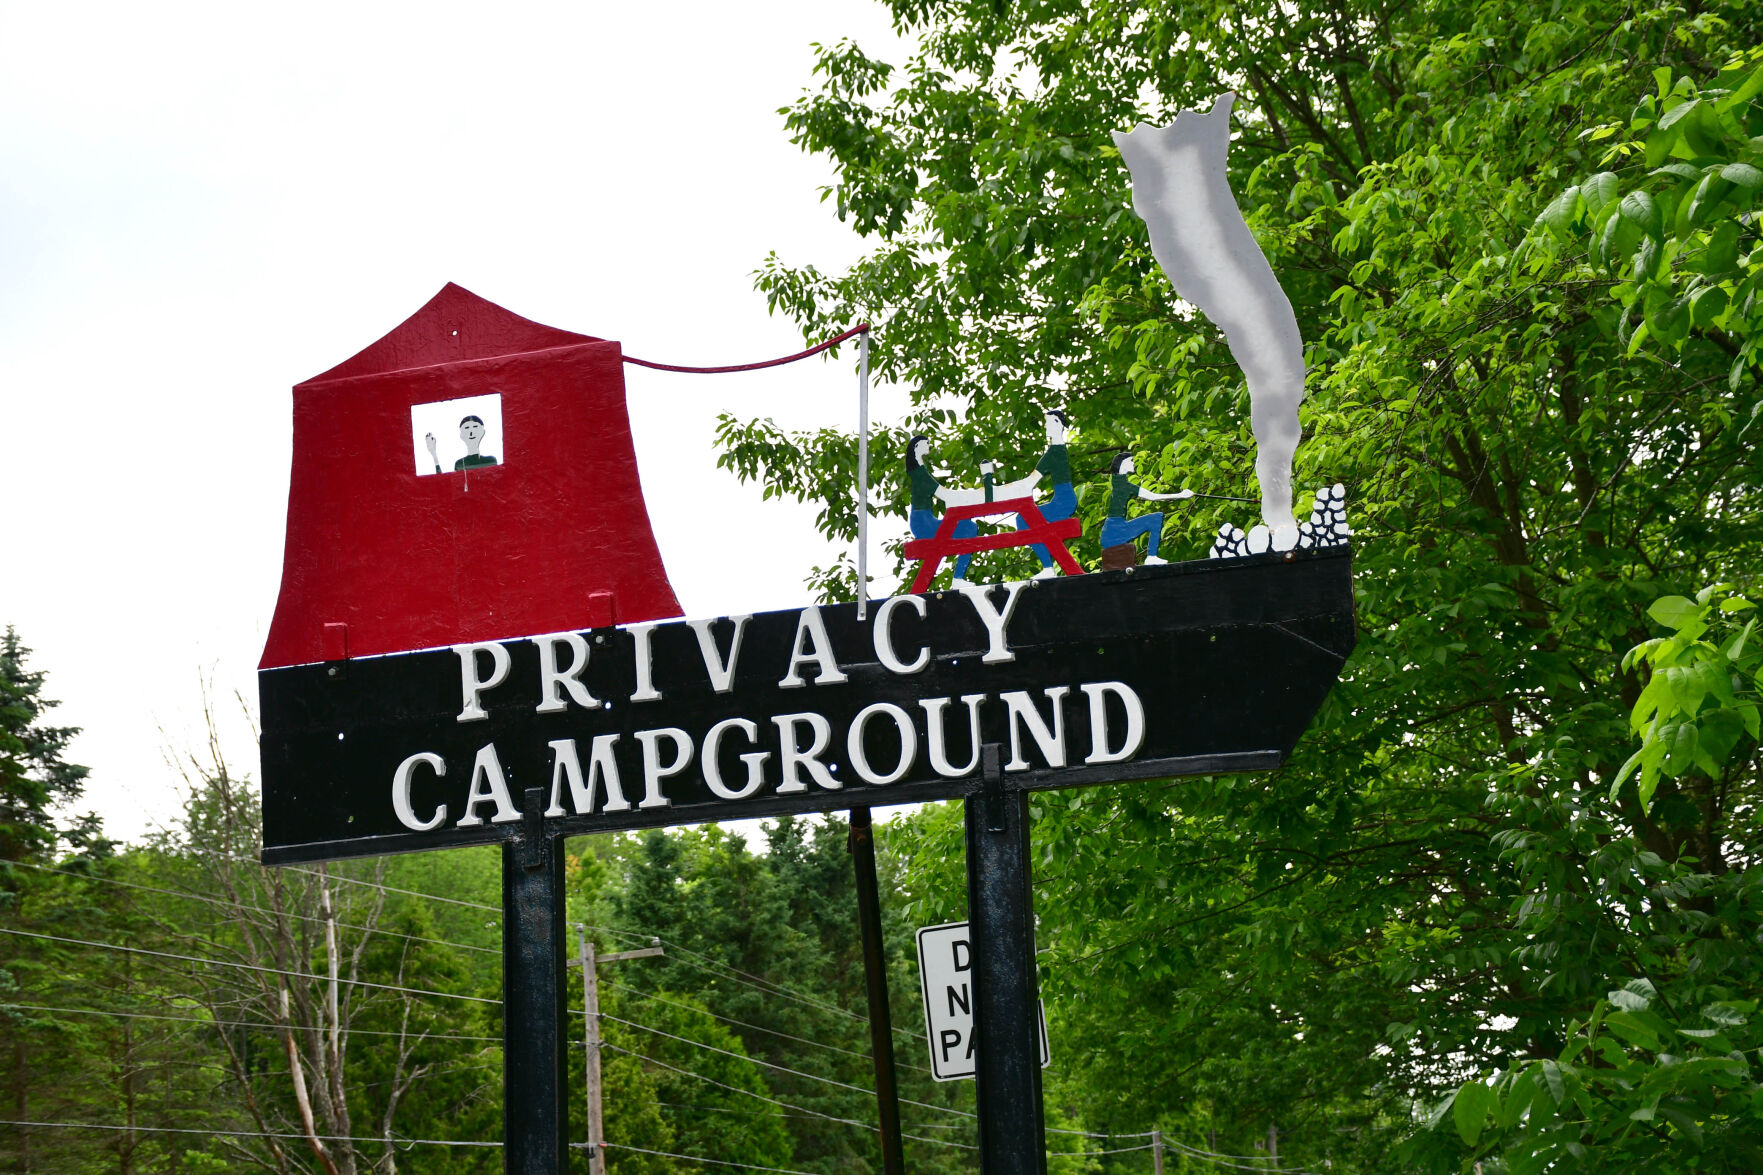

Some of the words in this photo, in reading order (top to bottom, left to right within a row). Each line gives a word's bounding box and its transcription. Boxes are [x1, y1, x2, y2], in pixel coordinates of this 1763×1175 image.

[452, 580, 1031, 723] PRIVACY
[391, 681, 1146, 832] CAMPGROUND
[951, 939, 971, 973] D
